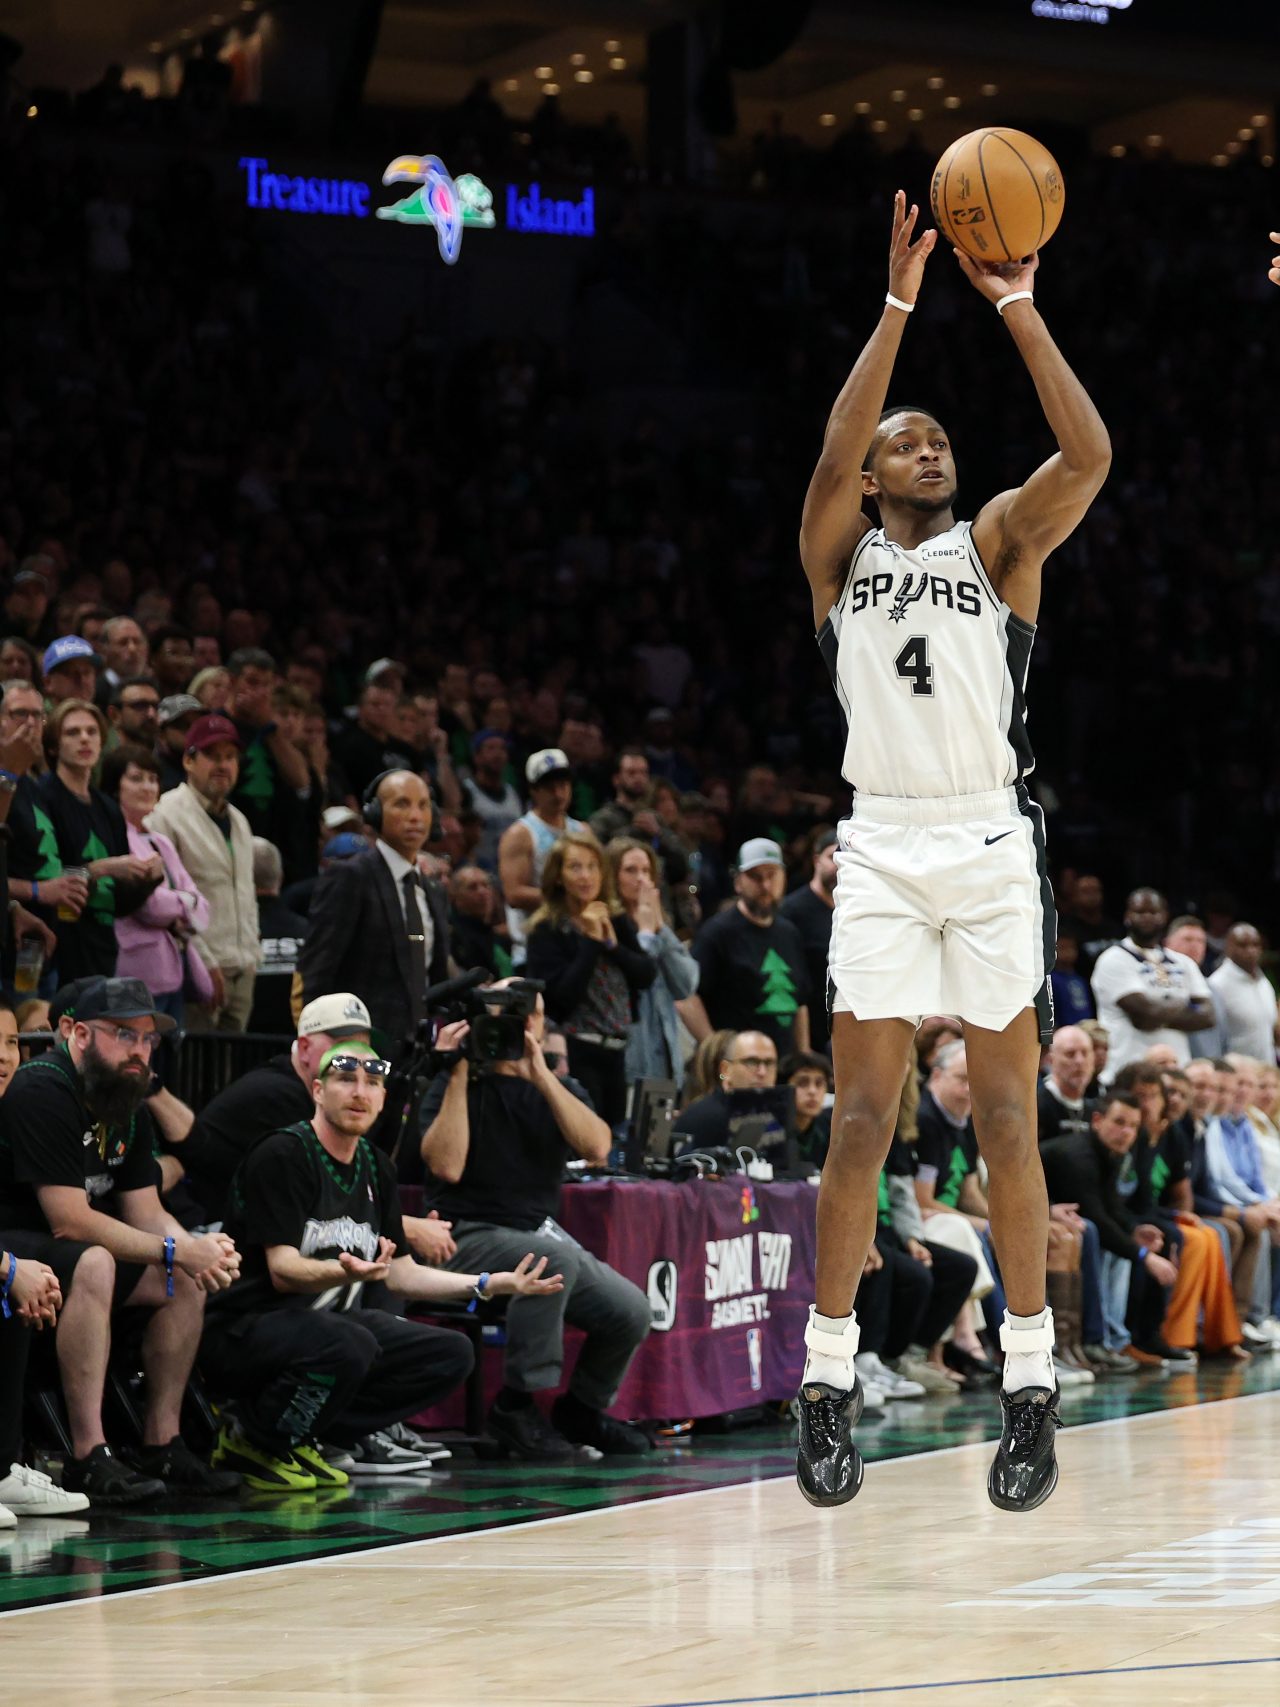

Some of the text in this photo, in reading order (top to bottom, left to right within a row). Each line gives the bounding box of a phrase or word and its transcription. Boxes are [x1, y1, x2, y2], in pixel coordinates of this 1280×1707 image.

[239, 157, 596, 238] Treasure Island
[926, 548, 961, 558] LEDGER
[852, 572, 982, 620] SPURS
[893, 634, 936, 698] 4
